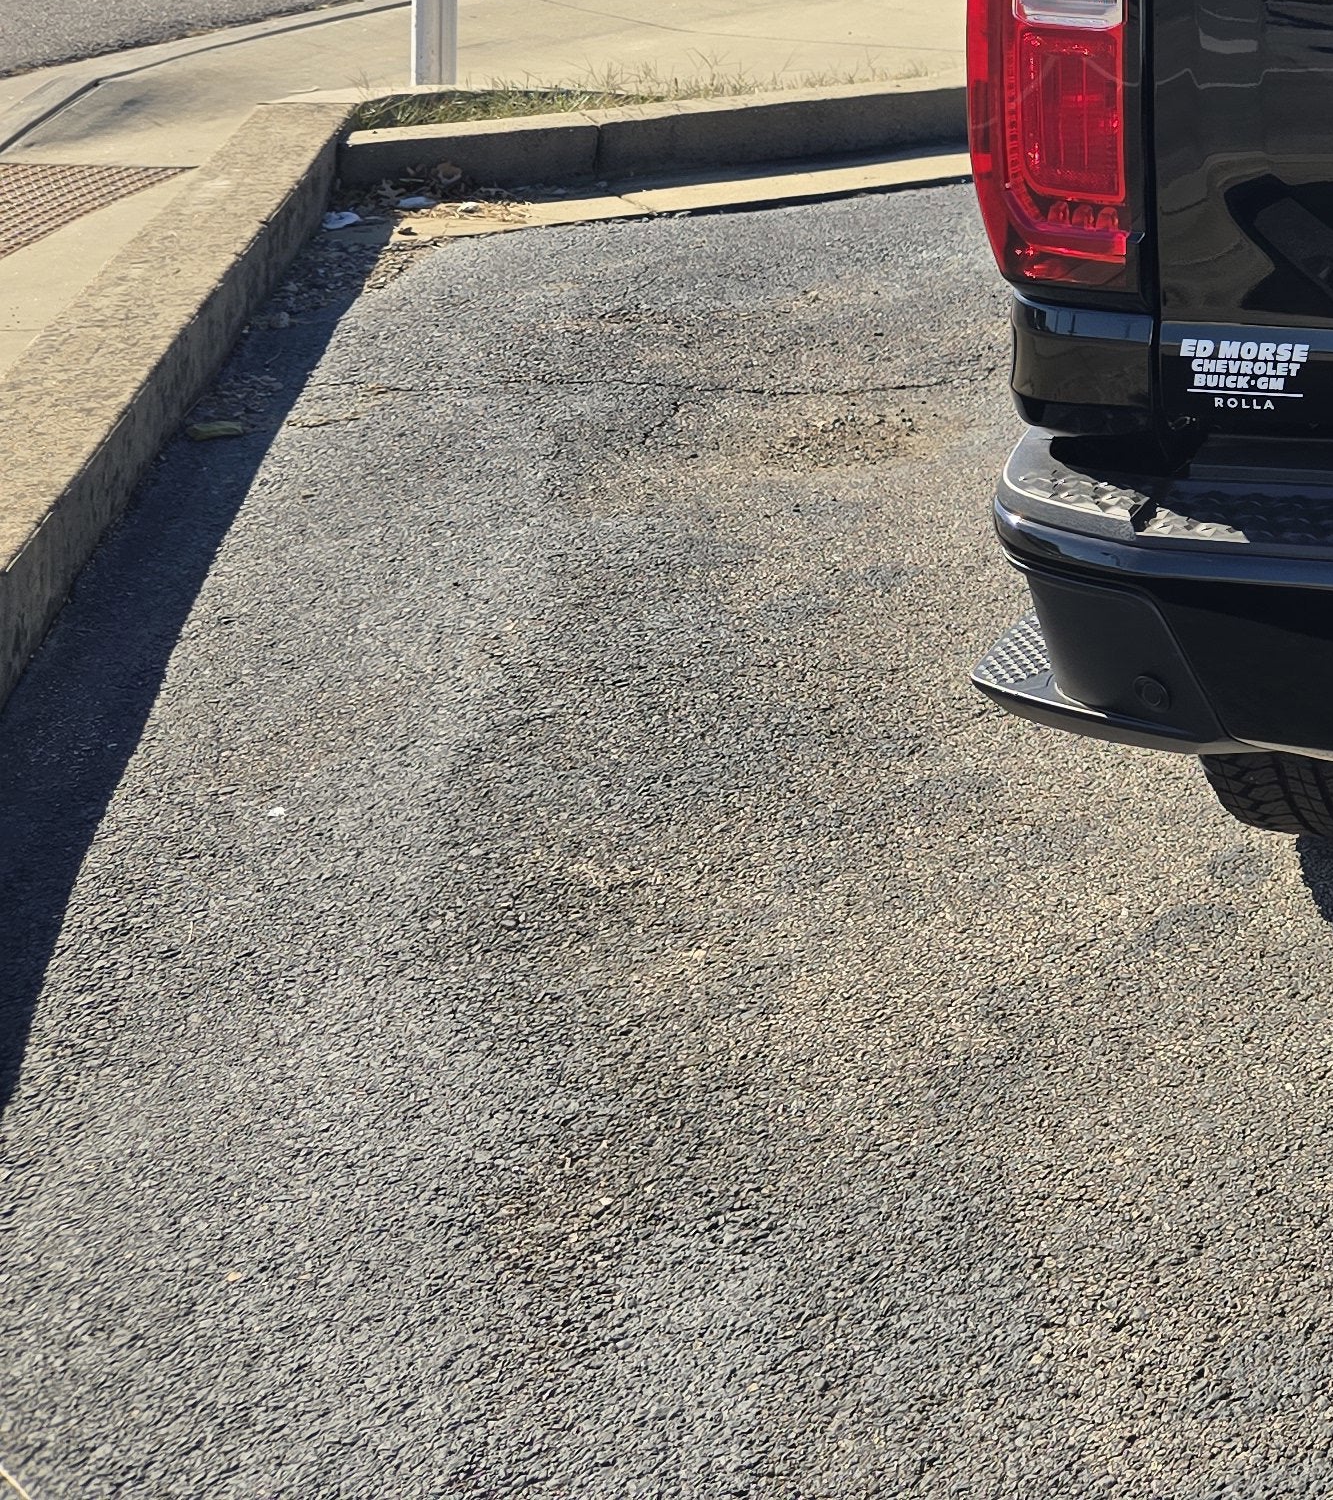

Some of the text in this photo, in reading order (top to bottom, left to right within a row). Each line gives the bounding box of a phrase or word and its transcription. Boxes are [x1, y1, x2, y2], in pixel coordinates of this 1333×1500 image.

[1179, 338, 1310, 363] ED MORSE
[1191, 358, 1301, 377] CHEVROLET
[1214, 397, 1275, 410] ROLLA
